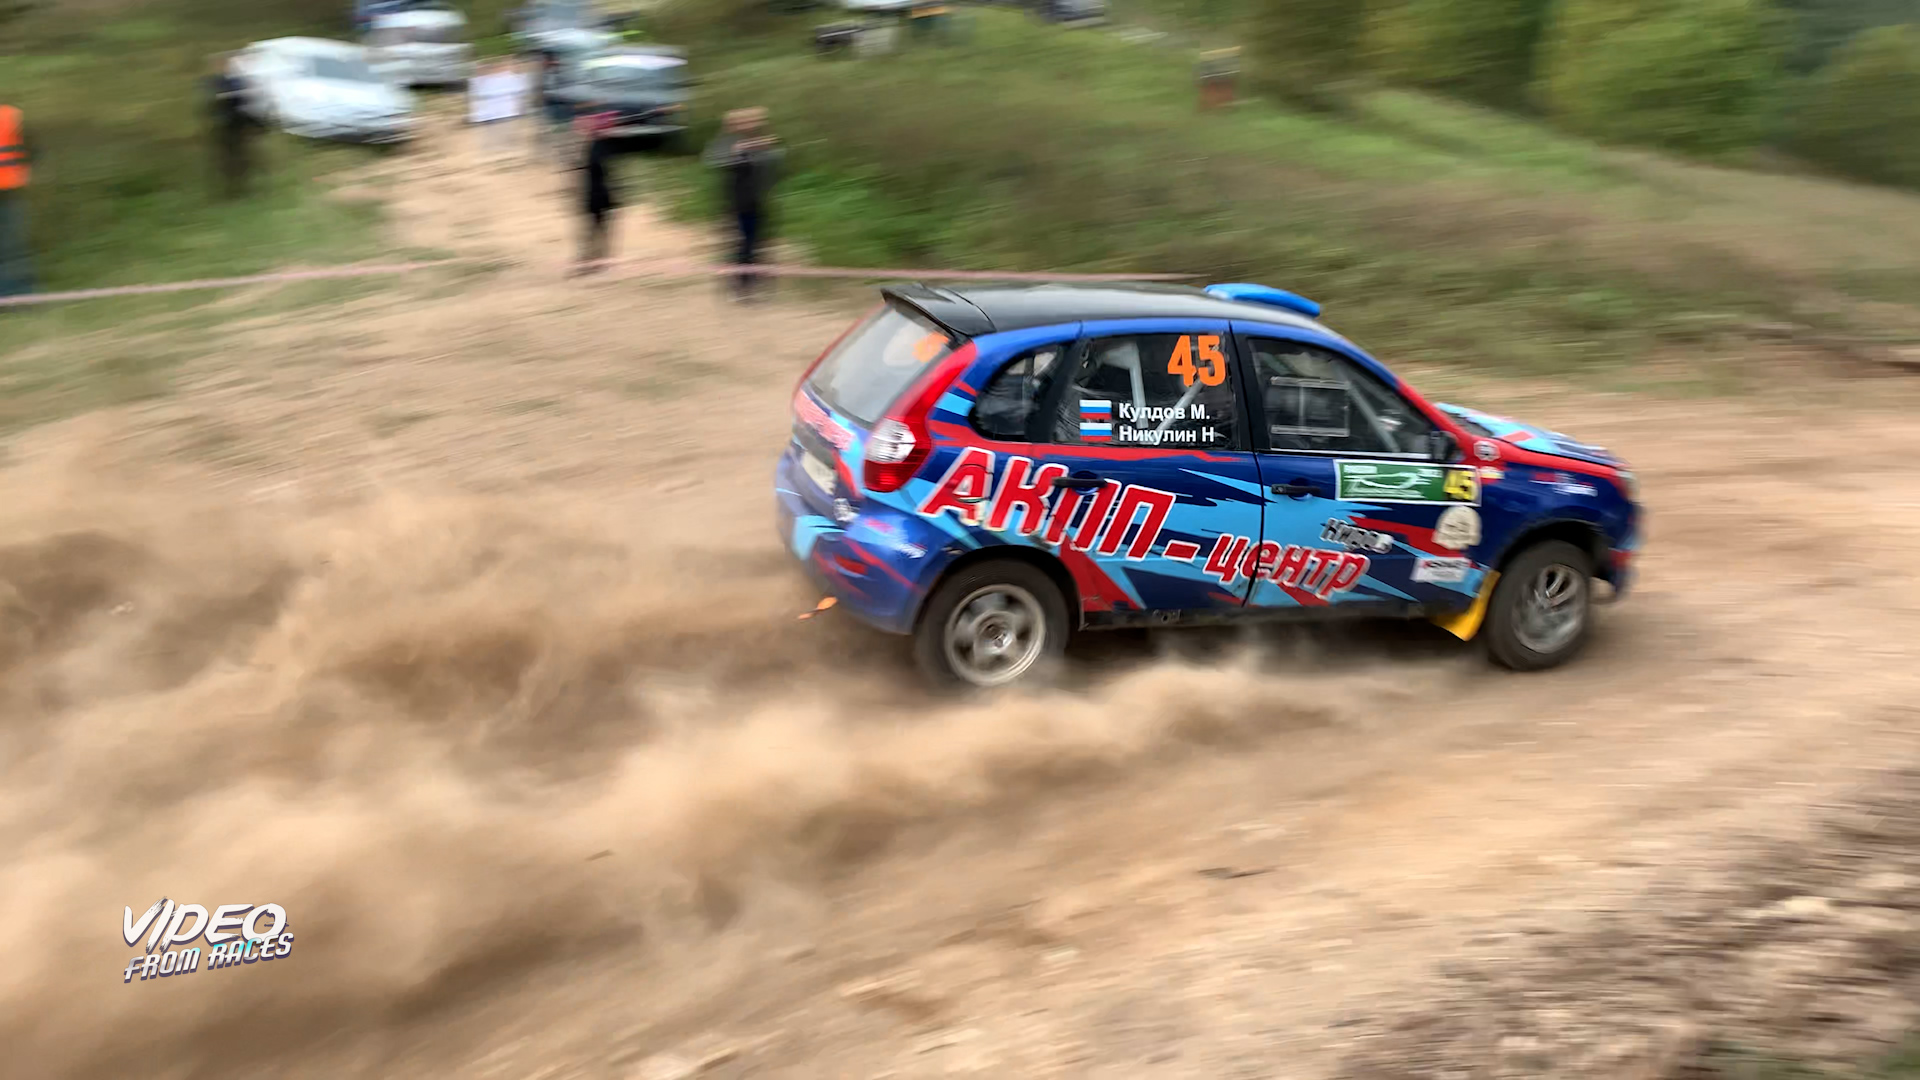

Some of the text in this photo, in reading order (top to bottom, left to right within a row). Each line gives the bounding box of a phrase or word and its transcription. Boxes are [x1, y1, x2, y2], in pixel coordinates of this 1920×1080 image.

[1167, 335, 1226, 387] 45
[1118, 402, 1211, 423] Кулдов М.
[1118, 425, 1215, 446] Никулин Н
